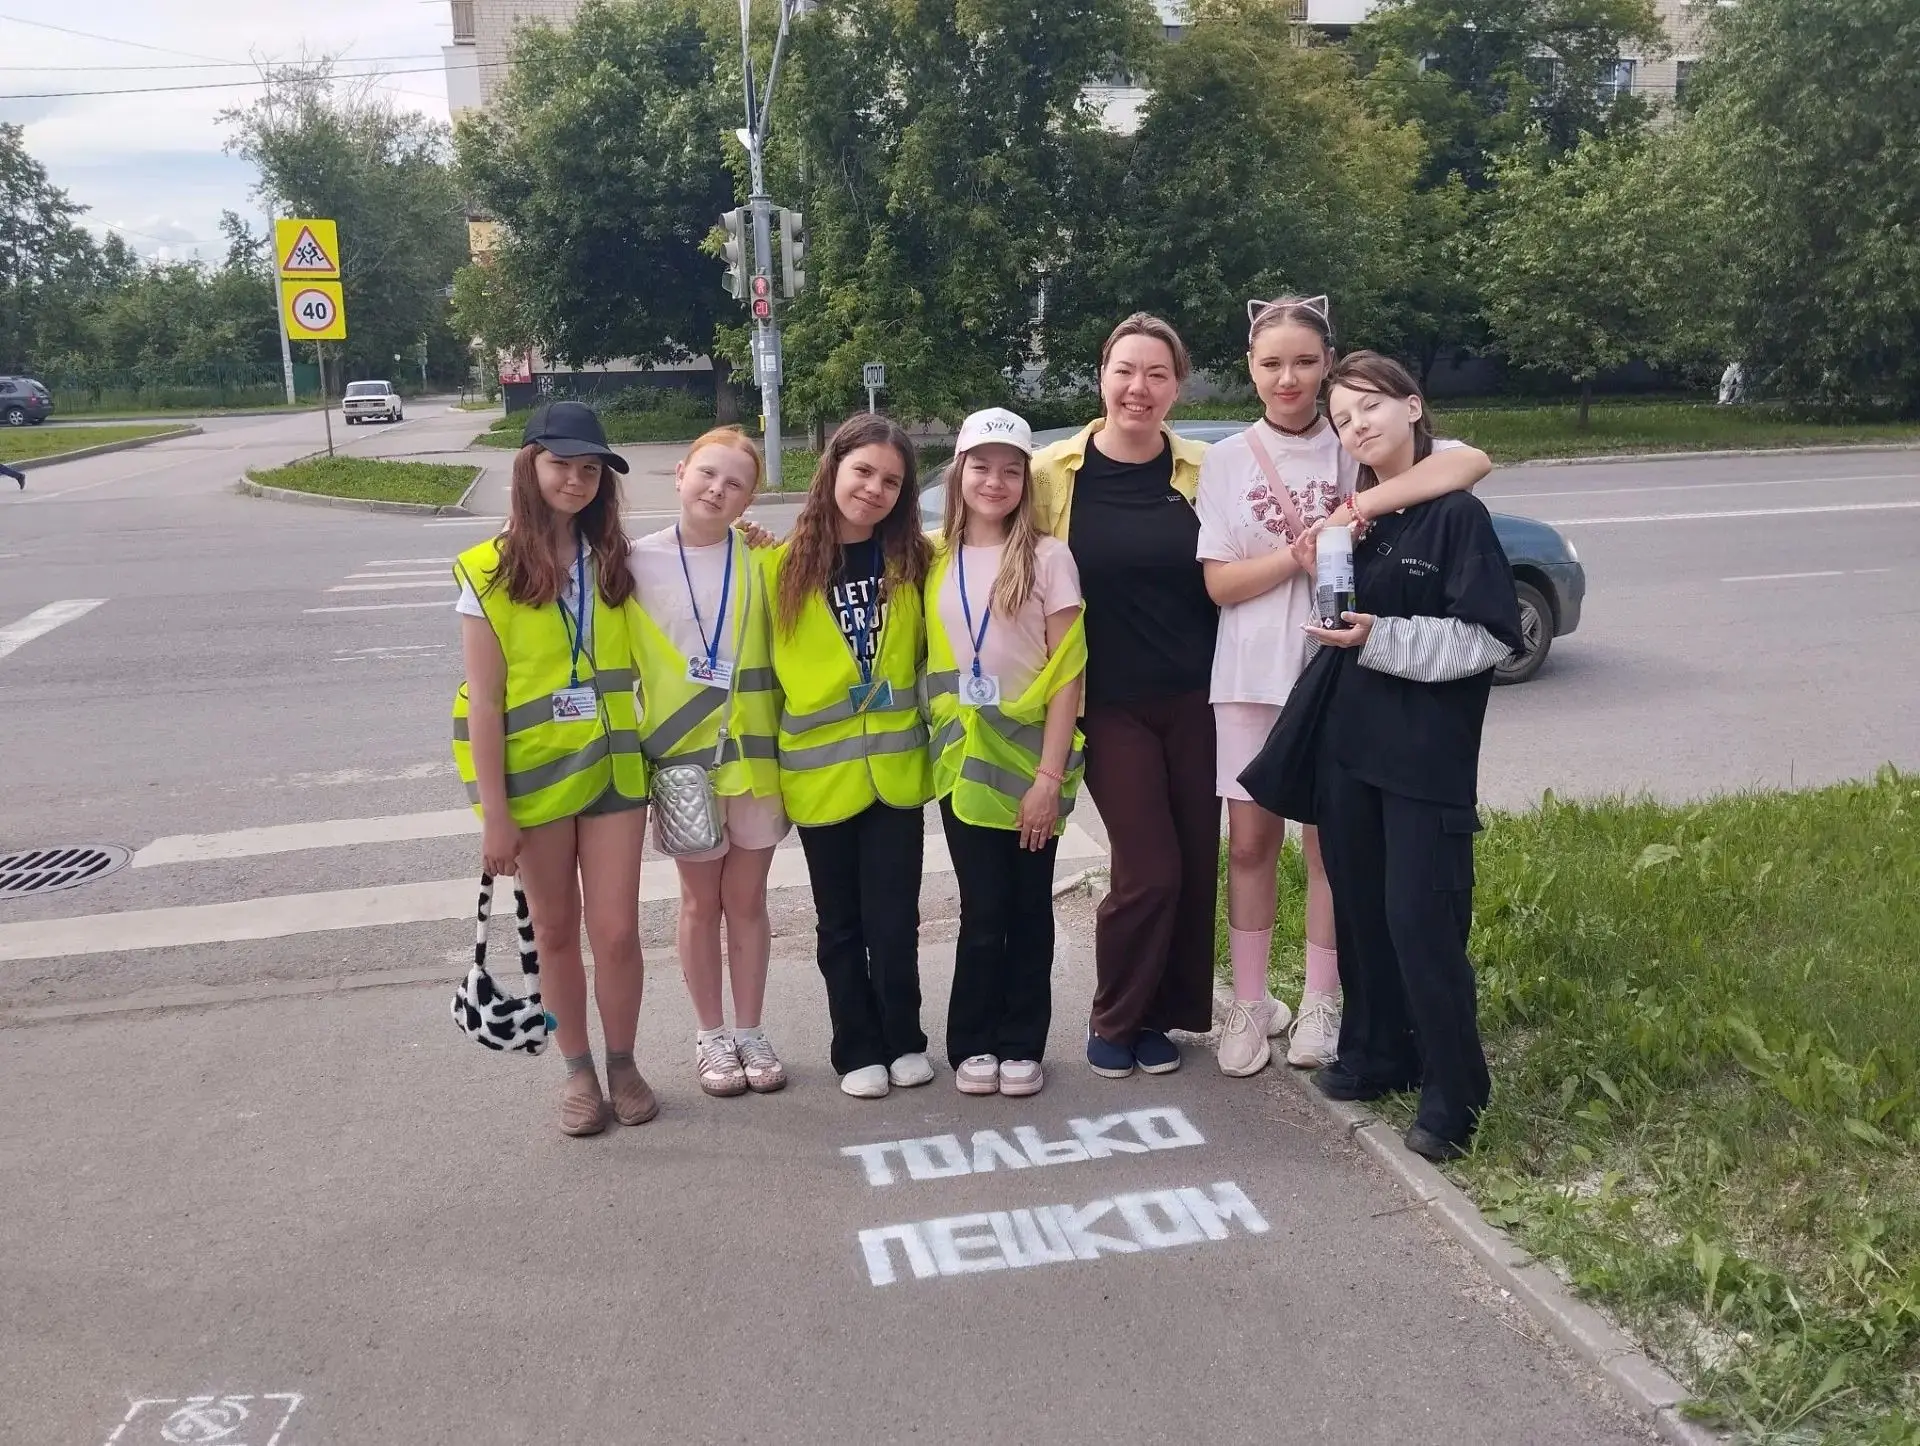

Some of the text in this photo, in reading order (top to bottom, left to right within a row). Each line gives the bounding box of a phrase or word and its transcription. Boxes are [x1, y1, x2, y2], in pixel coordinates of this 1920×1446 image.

[303, 302, 327, 320] 40
[867, 366, 883, 384] СТОП
[833, 576, 885, 607] LET'
[840, 603, 887, 633] CRO
[850, 632, 880, 656] TH
[840, 1107, 1206, 1187] ТОЛЬКО
[858, 1181, 1270, 1287] ПЕШКОМ
